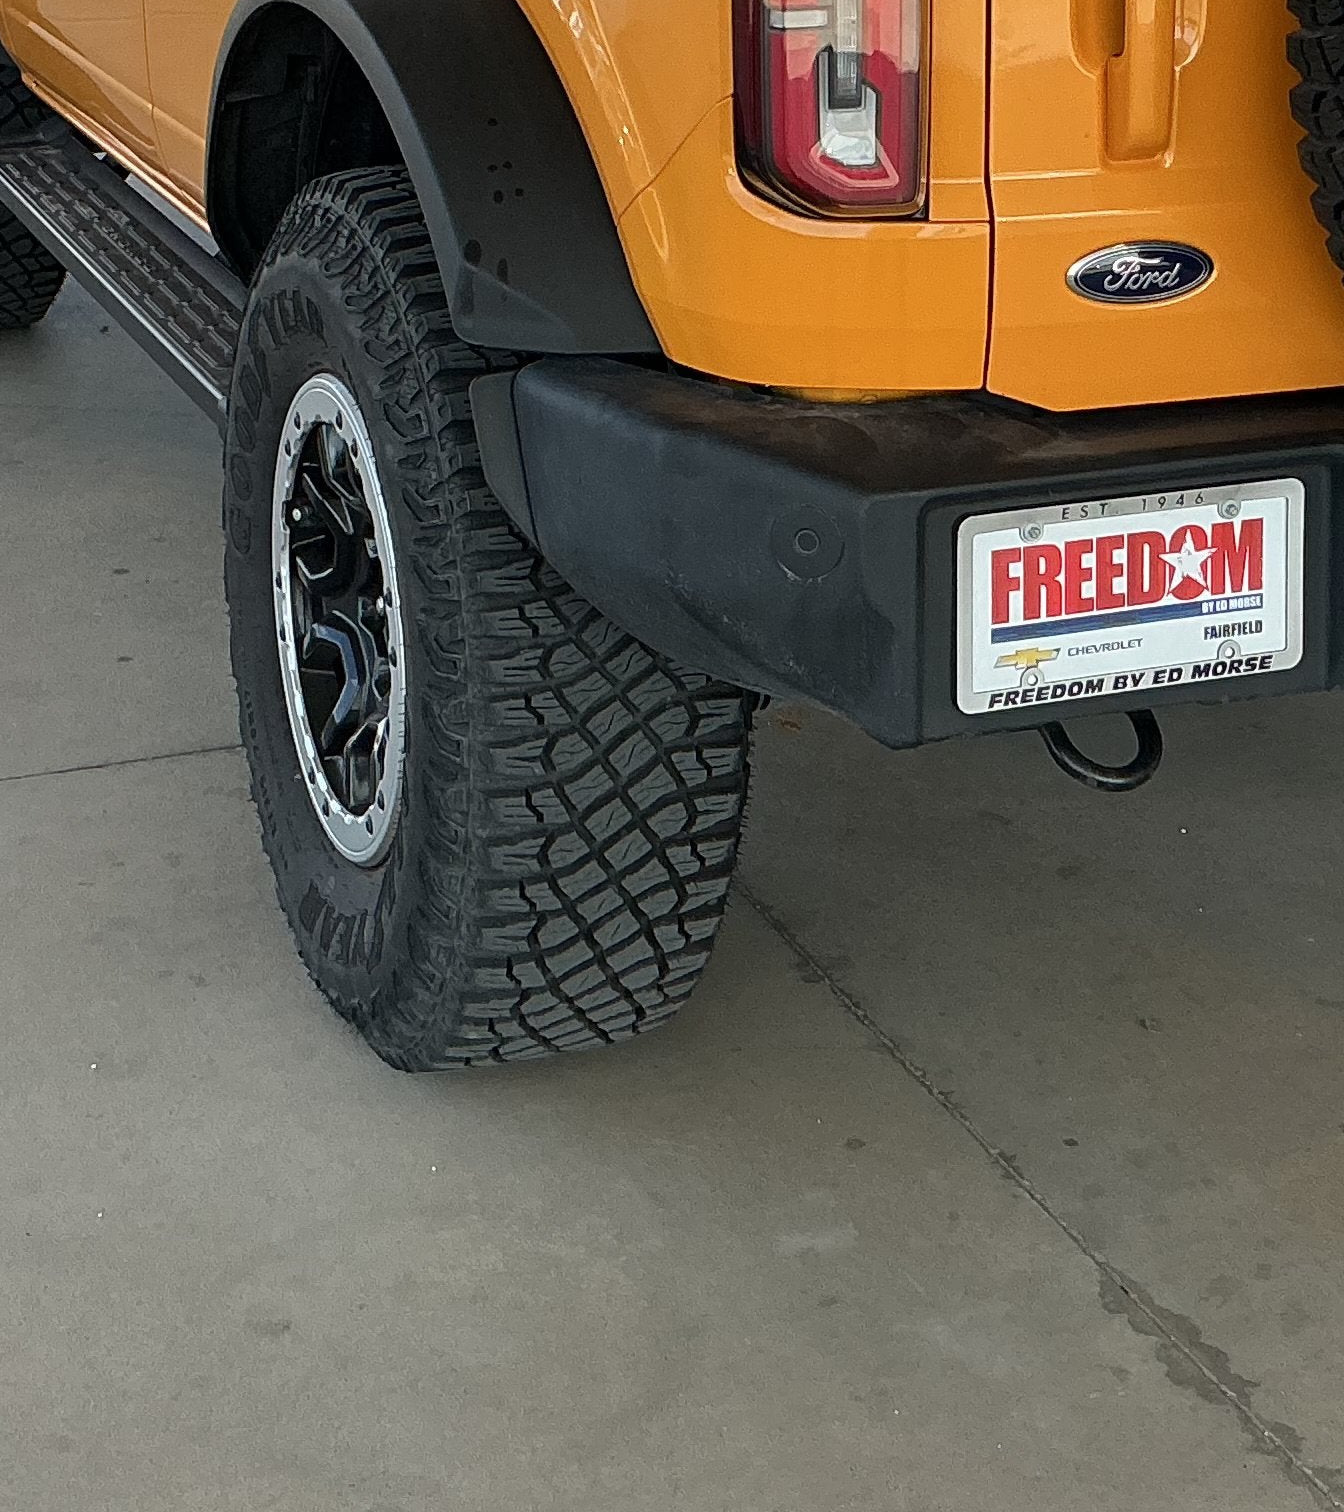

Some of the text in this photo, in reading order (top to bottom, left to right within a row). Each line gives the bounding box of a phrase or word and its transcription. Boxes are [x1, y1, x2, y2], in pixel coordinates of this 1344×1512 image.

[1103, 256, 1183, 293] Ford
[1061, 492, 1206, 521] EST. 1946
[991, 517, 1265, 625] FREEDOM
[1203, 620, 1263, 640] FAIRFIELD
[1067, 638, 1144, 657] CHEVROLET
[988, 655, 1274, 710] FREEDOM BY ED MORSE
